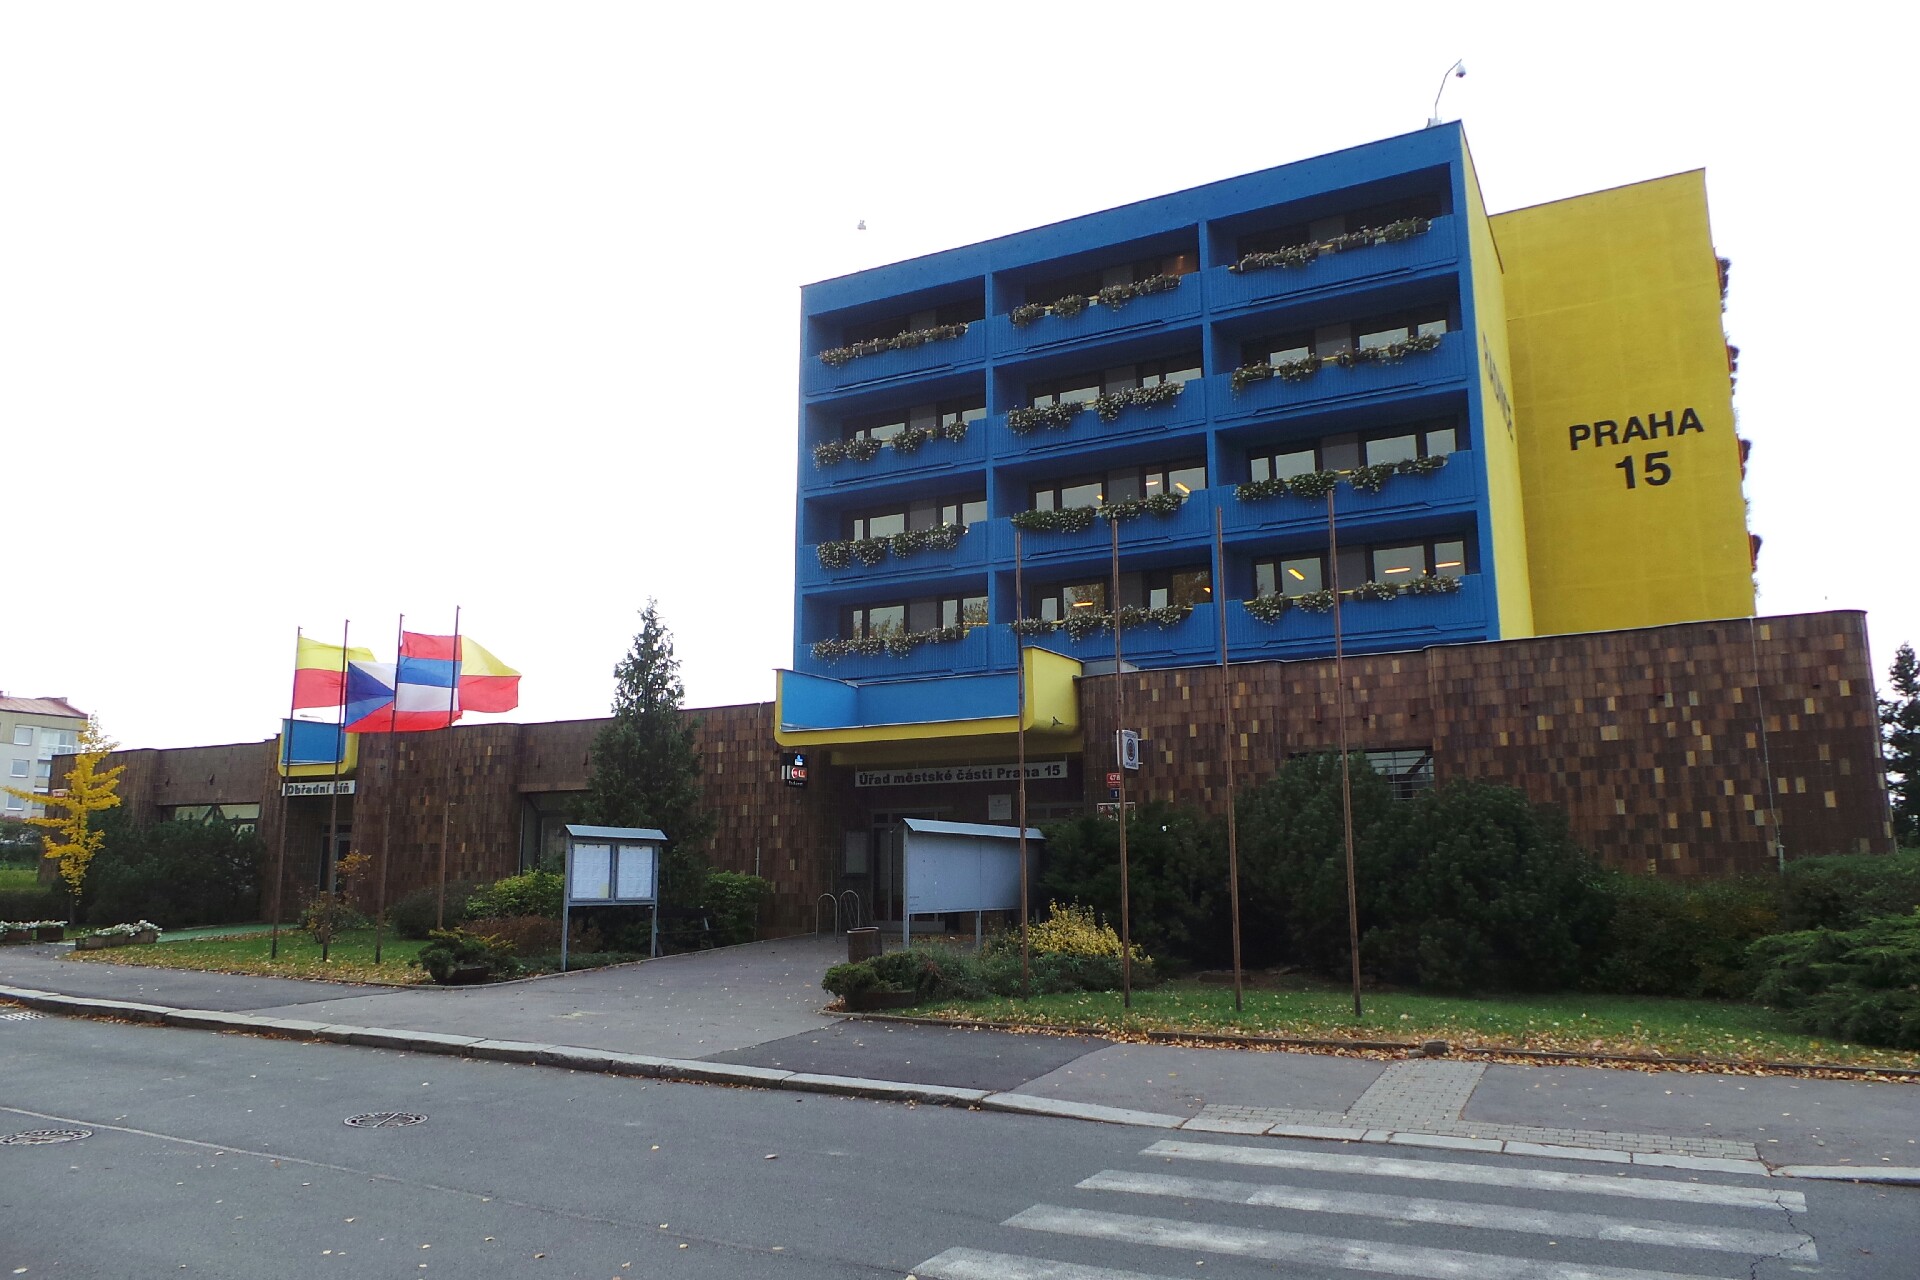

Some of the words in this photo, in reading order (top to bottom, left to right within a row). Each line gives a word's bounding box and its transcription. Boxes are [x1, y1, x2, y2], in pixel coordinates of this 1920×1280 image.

[1569, 407, 1704, 451] PRAHA
[1615, 450, 1671, 489] 15
[286, 783, 330, 795] Obřadní
[859, 772, 890, 785] Úřad
[893, 770, 953, 784] městské
[956, 768, 993, 781] části
[997, 766, 1040, 779] Praha
[1045, 764, 1061, 776] 15
